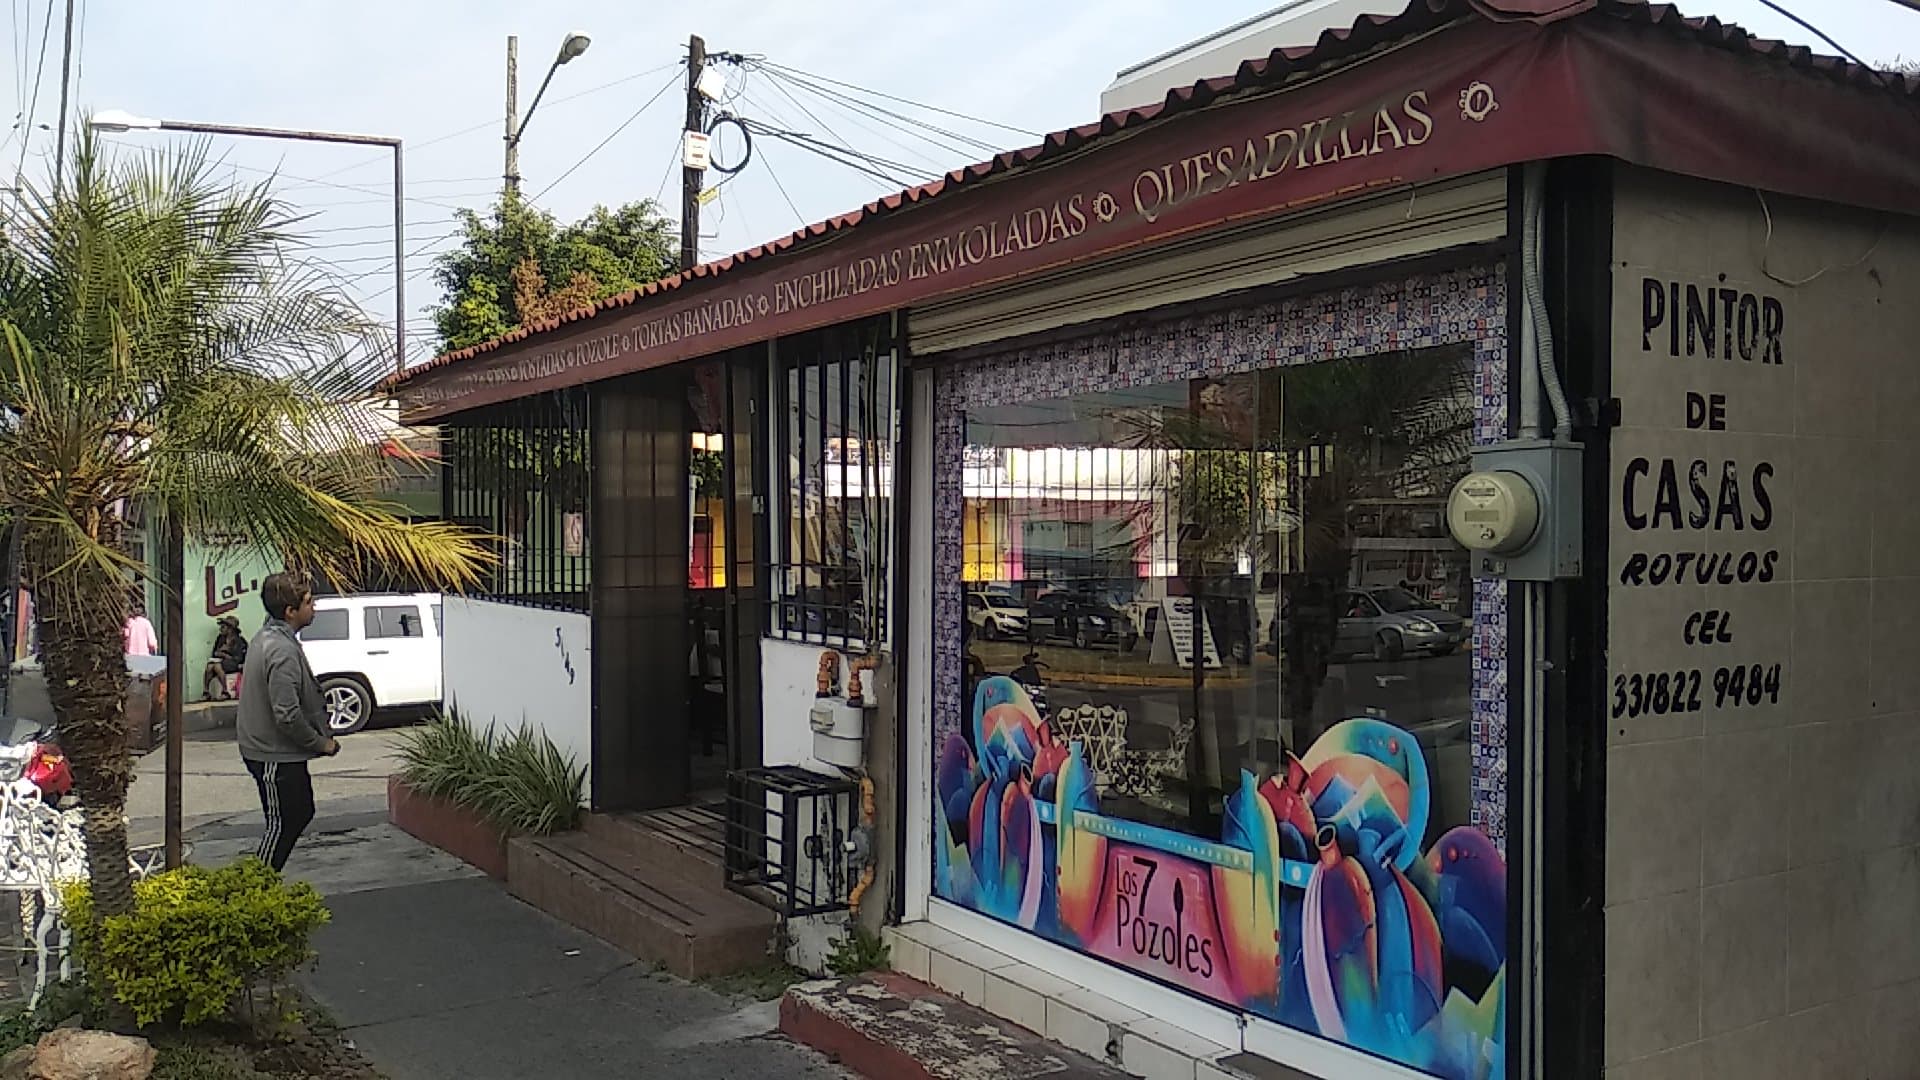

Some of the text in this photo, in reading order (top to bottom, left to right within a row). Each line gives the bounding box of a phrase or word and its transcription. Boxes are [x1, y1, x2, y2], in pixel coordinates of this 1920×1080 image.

[518, 89, 1434, 383] TOSTADAS POZOLE TORTAS BAÑADAS ENCHILADAS ENMOLADAS QUESADILLAS
[1642, 277, 1784, 365] PINTOR
[1686, 391, 1727, 431] DE
[1623, 457, 1775, 532] CASAS
[1620, 550, 1779, 586] ROTULOS
[1683, 609, 1733, 645] CEL
[1611, 663, 1782, 720] 331822 9484
[1133, 856, 1158, 917] 7
[1116, 877, 1213, 978] Pozoles
